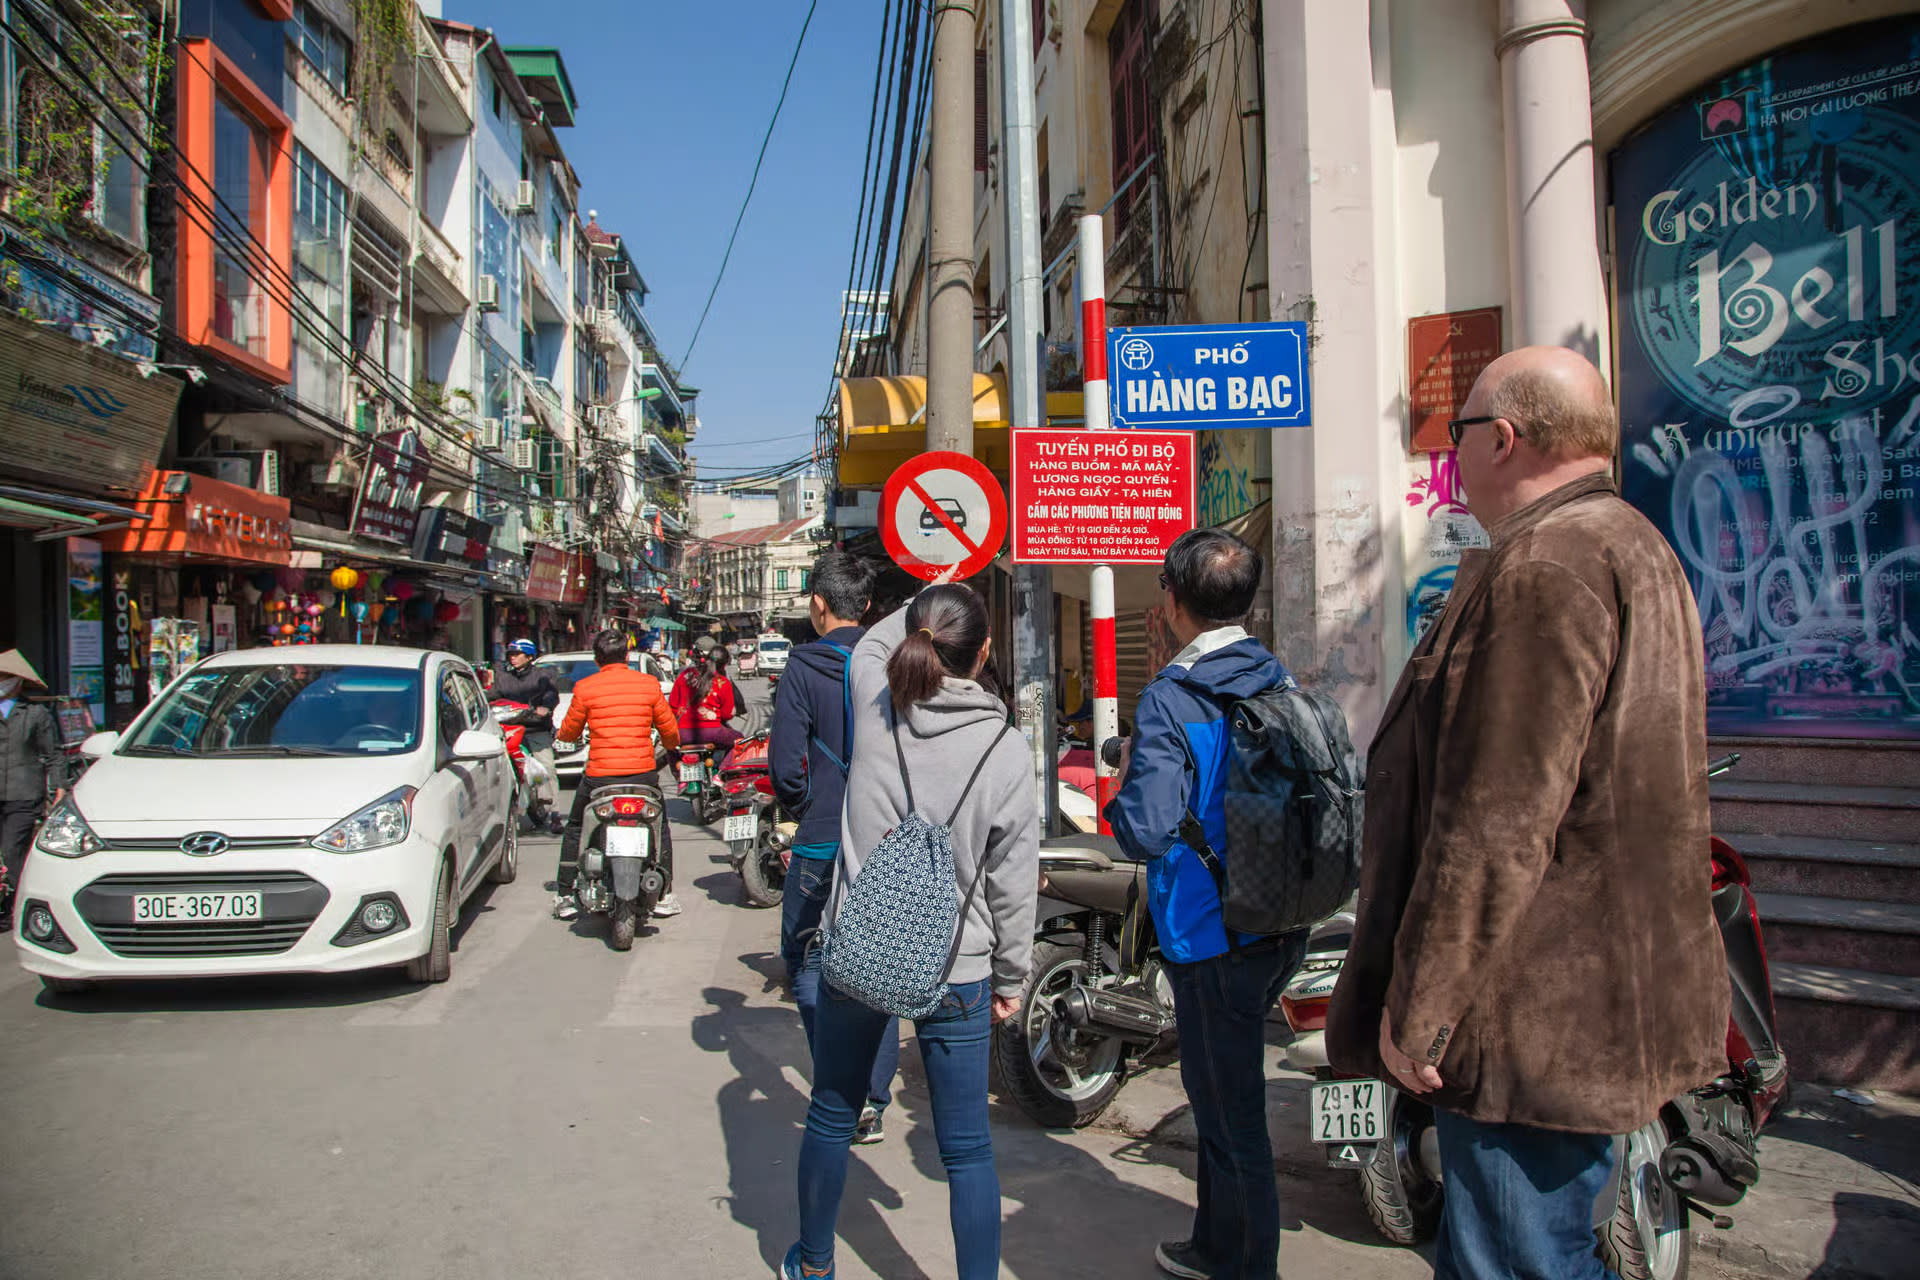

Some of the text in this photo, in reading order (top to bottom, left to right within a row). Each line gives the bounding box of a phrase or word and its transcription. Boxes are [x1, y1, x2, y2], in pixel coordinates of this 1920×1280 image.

[1837, 76, 1850, 88] OF
[1760, 114, 1778, 128] HA
[1782, 105, 1807, 122] NOI
[1811, 100, 1832, 116] CAI
[1836, 87, 1887, 111] LUONG
[1642, 175, 1817, 246] Golden
[1689, 219, 1898, 368] Bell
[1195, 340, 1250, 365] PHỐ
[1126, 370, 1292, 416] HÀNG BẠC
[1036, 437, 1175, 461] TUYẾN PHỐ ĐI BỘ
[1703, 421, 1816, 456] unique
[1029, 459, 1068, 470] HÀNG
[1033, 474, 1080, 484] LƯƠNG
[1083, 474, 1121, 486] NGỌC
[1124, 473, 1169, 485] QUYẾN
[1038, 486, 1076, 497] HÀNG
[1122, 489, 1139, 499] TẠ
[1027, 500, 1182, 523] CẤM CÁC PHƯƠNG TIỆN HOẠT ĐỘNG
[1027, 523, 1046, 533] MÙA
[1027, 535, 1046, 544] MÙA
[1027, 546, 1051, 556] NGÀY
[1053, 546, 1069, 555] THỨ
[1092, 546, 1108, 556] THỨ
[1128, 546, 1140, 556] VÀ
[1321, 1111, 1376, 1138] 2166
